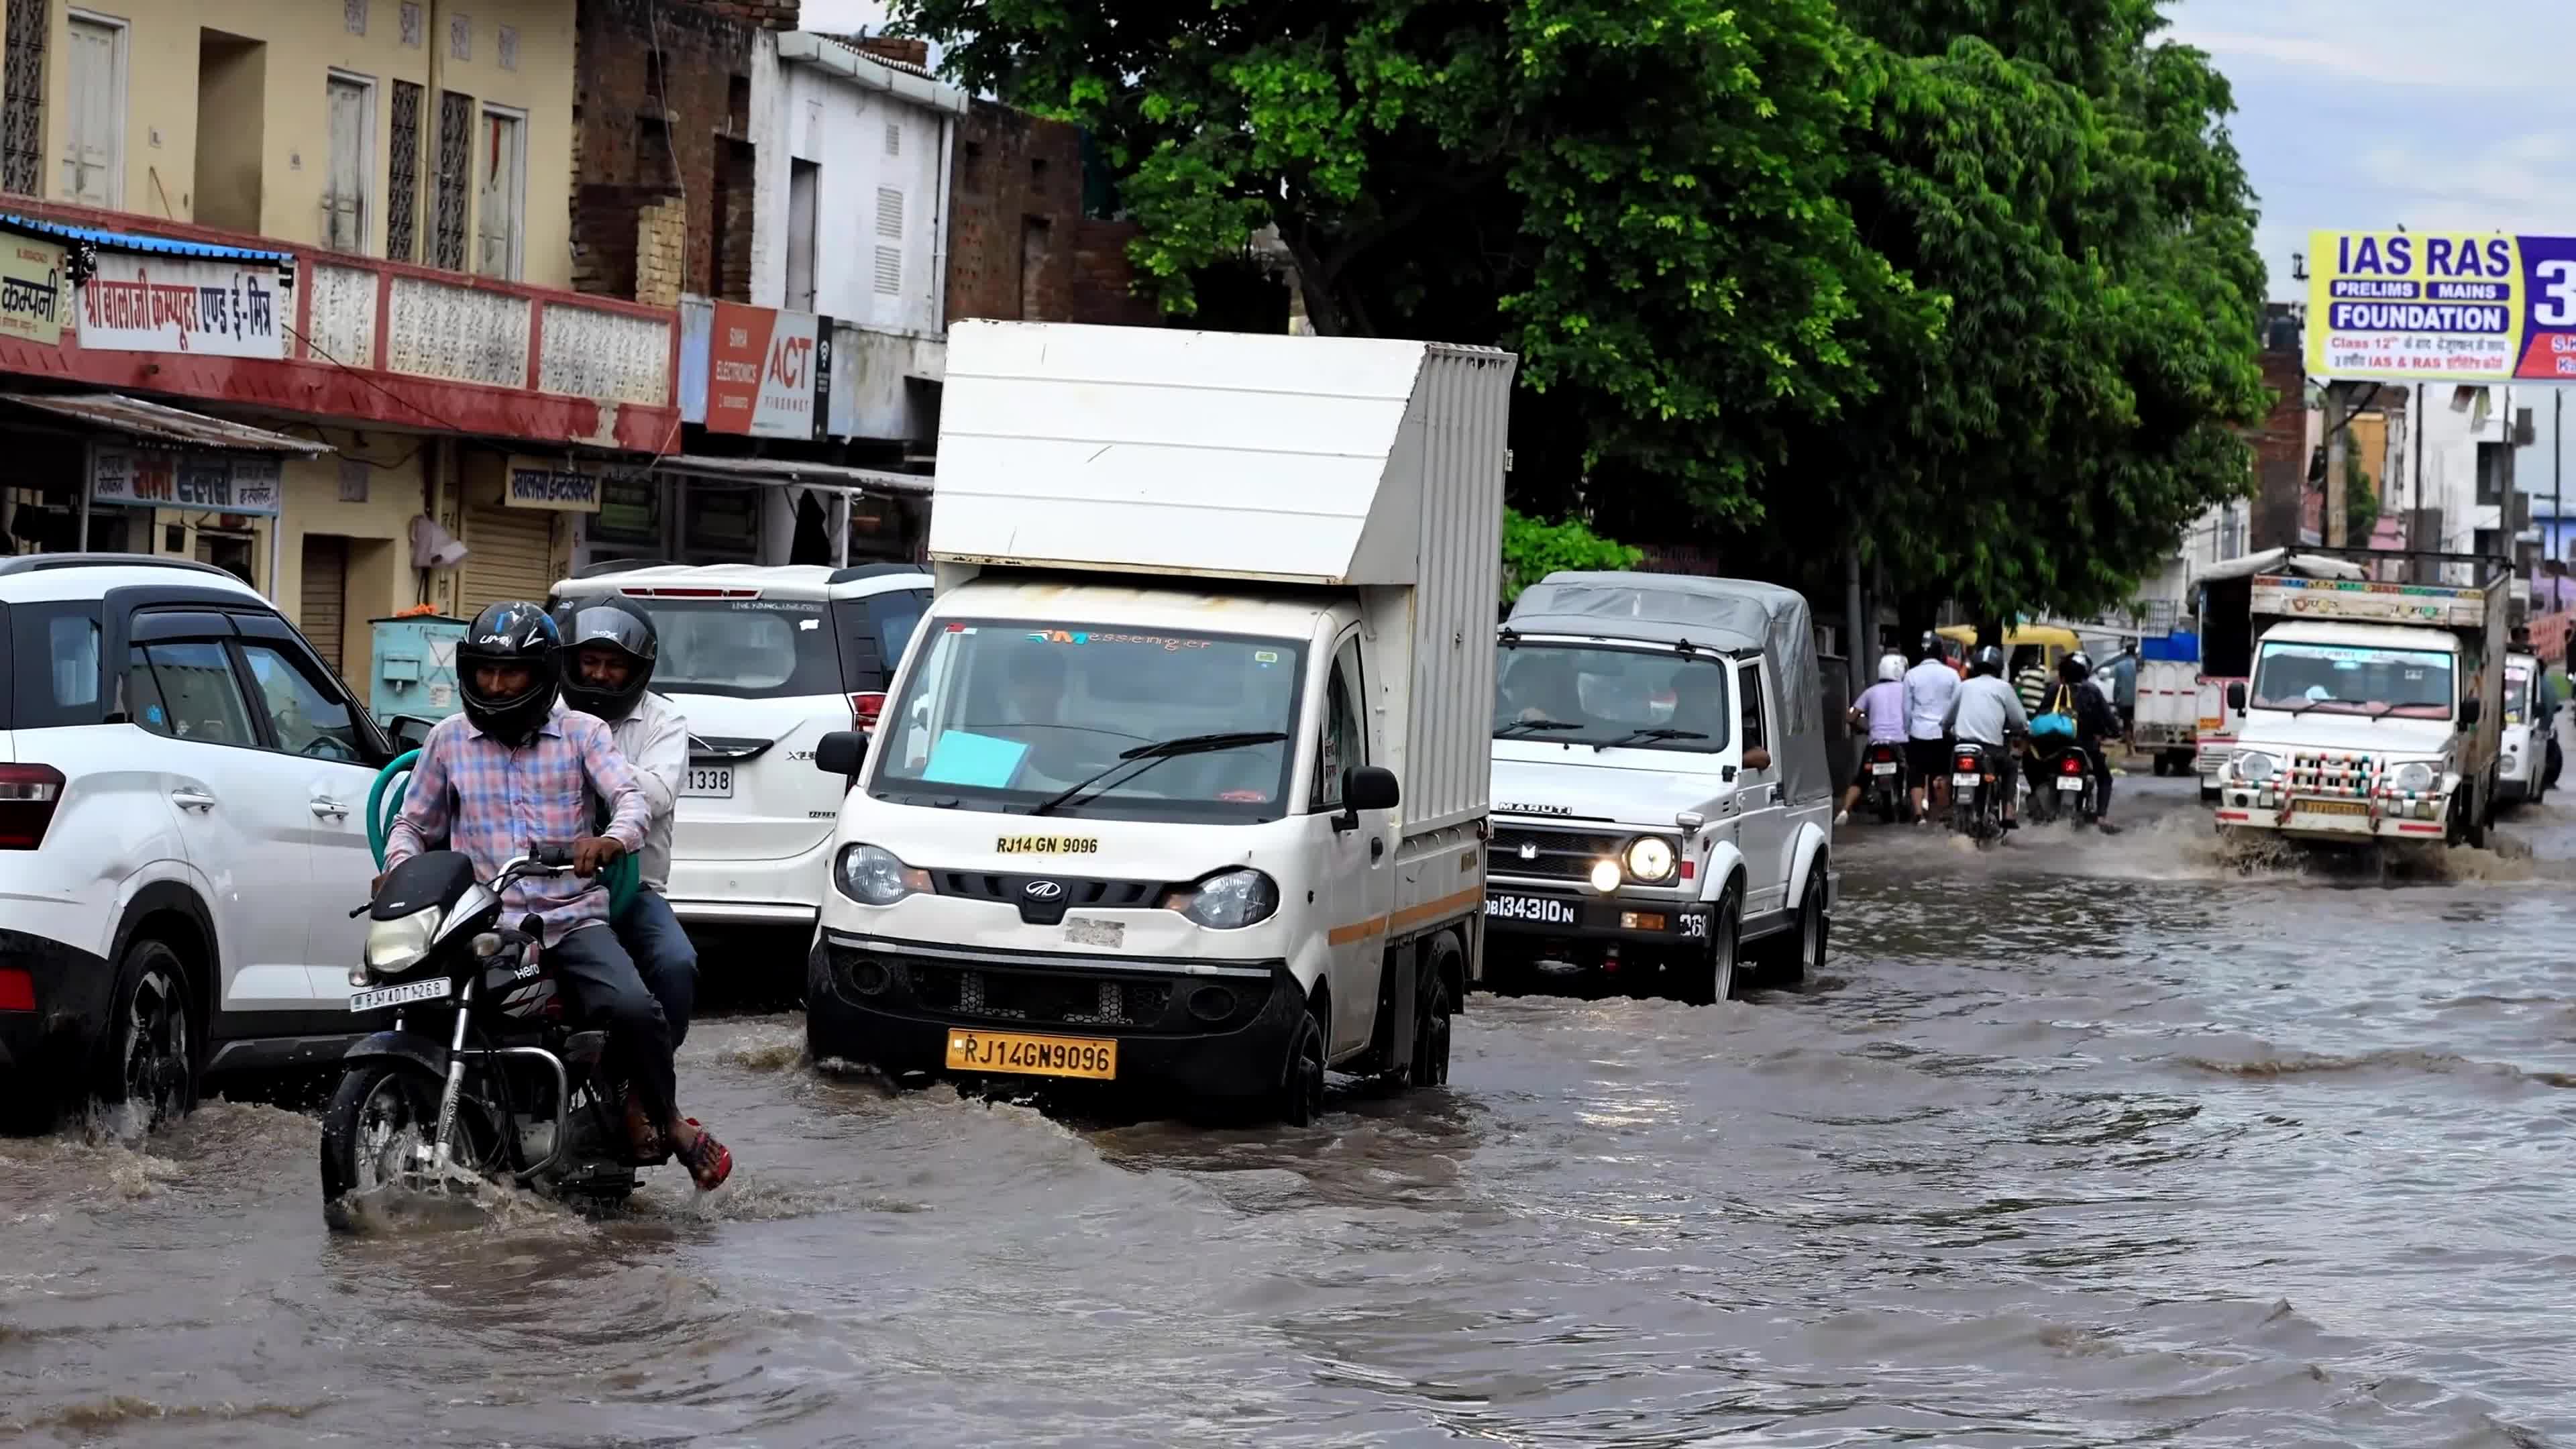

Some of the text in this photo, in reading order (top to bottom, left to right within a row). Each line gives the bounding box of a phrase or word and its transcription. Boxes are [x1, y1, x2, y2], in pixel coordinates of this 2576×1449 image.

[2339, 236, 2511, 277] IAS RAS
[2, 268, 58, 323] कम्पनी
[101, 268, 150, 331] बालाजी
[2335, 281, 2498, 299] PRELIMS MAINS
[2337, 305, 2502, 331] FOUNDATION
[2332, 337, 2369, 348] Class
[768, 335, 812, 390] ACT
[688, 771, 729, 790] 1338
[1498, 802, 1572, 815] MARUTI
[997, 837, 1098, 853] RJ14 GN 9096
[514, 963, 540, 980] Hero
[965, 1037, 1110, 1072] RJ14GN9096
